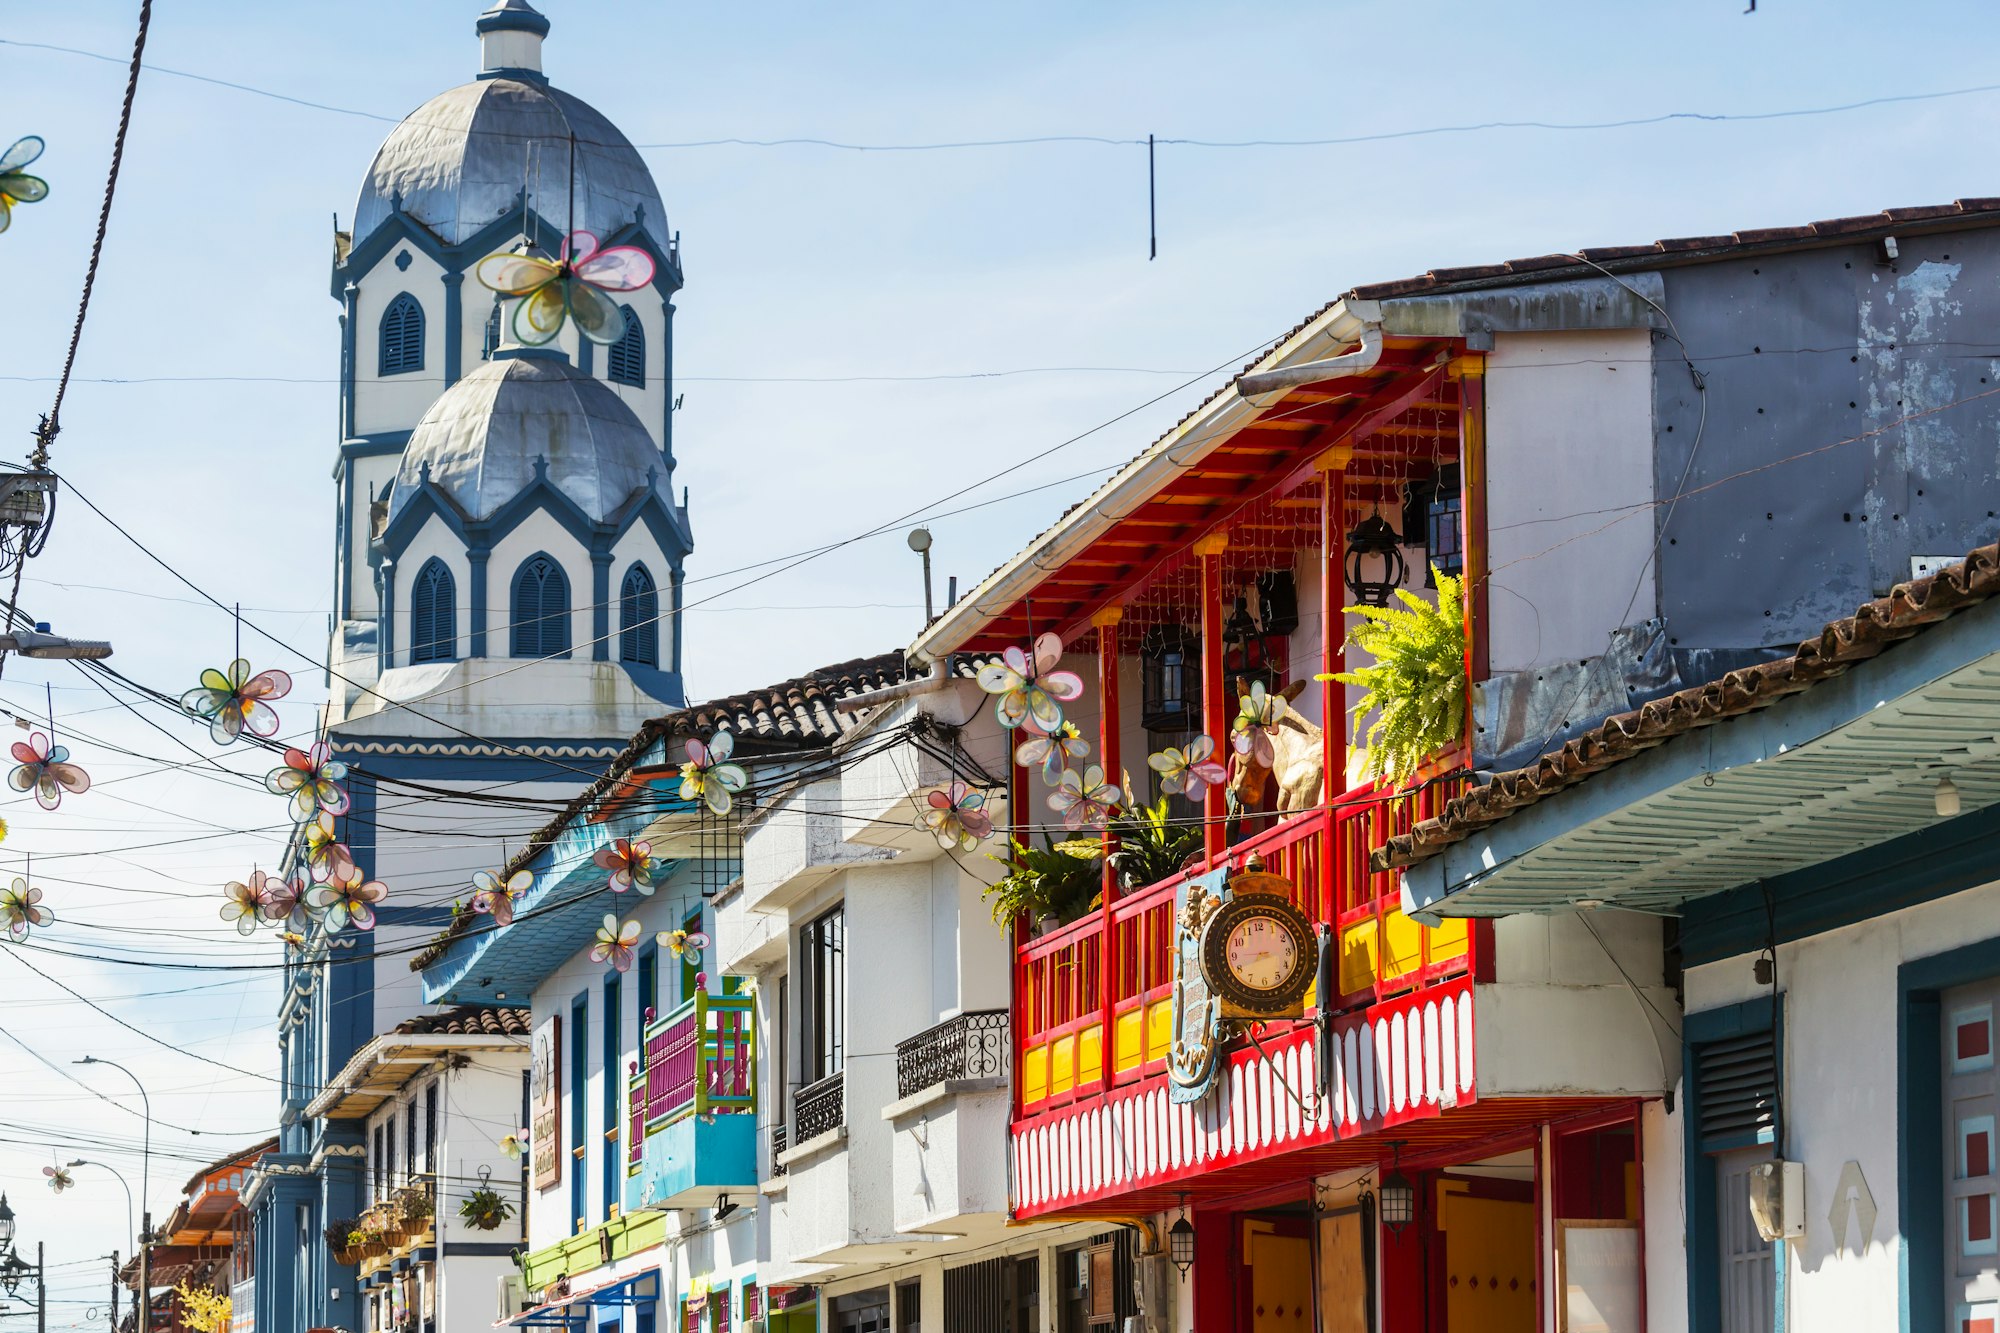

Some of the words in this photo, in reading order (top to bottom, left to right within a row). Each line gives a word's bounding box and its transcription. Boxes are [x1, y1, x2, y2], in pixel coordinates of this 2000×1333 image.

[1242, 927, 1252, 936] 11
[1254, 922, 1264, 932] 12
[1234, 938, 1244, 947] 10
[1280, 934, 1286, 943] 2
[1231, 952, 1237, 961] 9
[1285, 948, 1291, 956] 3
[1236, 965, 1243, 973] 8
[1283, 961, 1288, 969] 4
[1248, 974, 1253, 983] 7
[1275, 971, 1281, 980] 5
[1262, 977, 1268, 986] 6
